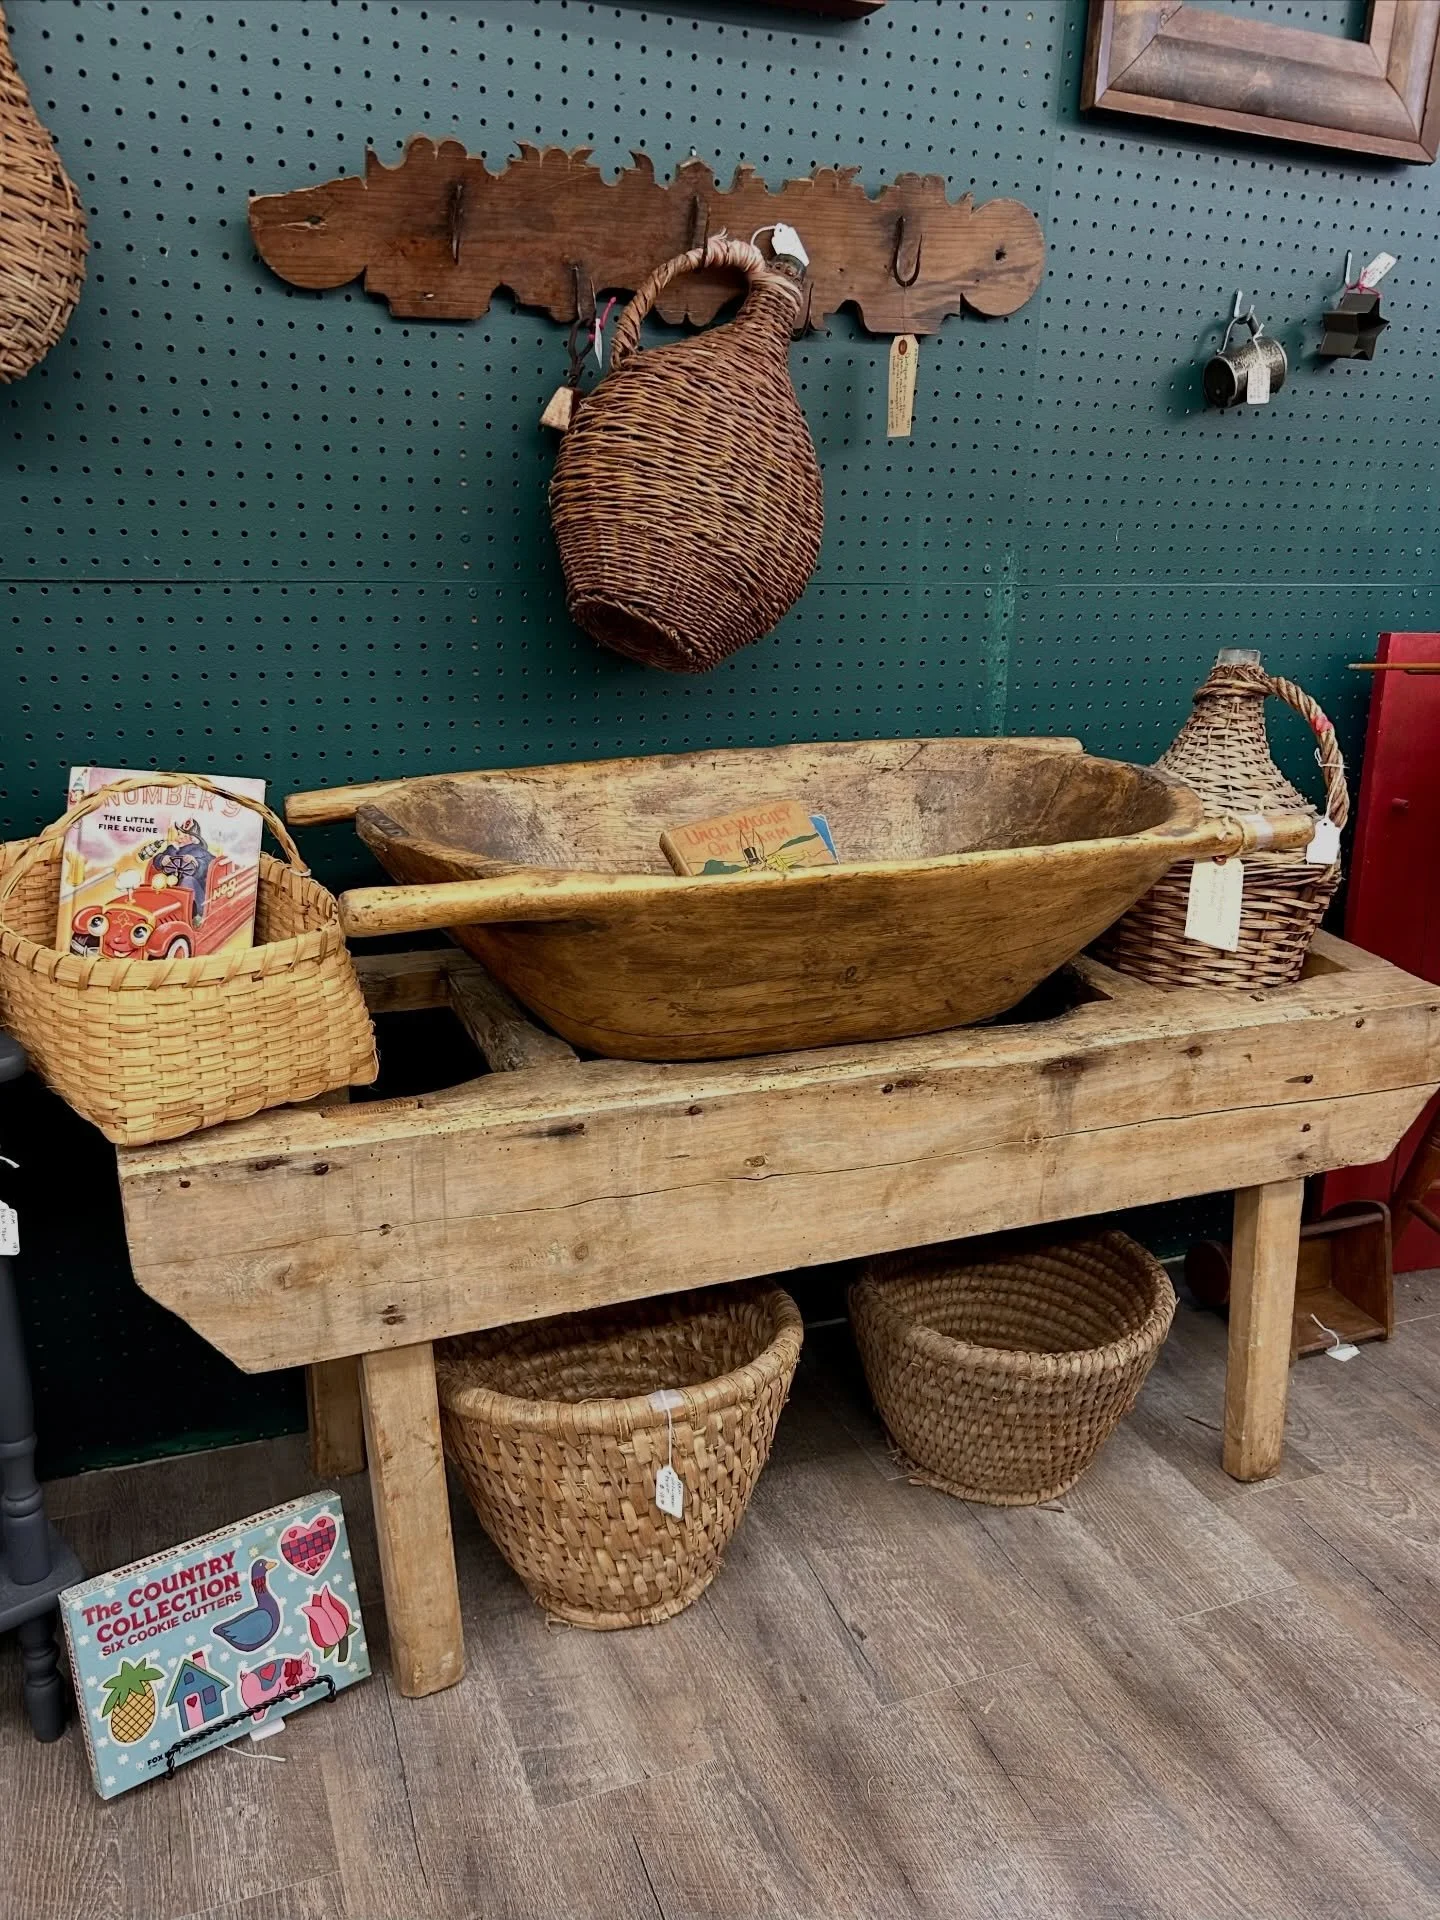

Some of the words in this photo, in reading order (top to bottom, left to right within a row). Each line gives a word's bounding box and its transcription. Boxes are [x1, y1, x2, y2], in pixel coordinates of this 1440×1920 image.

[98, 824, 120, 832] FIRE
[123, 825, 159, 834] ENGINE
[104, 814, 122, 822] THE
[125, 816, 155, 825] LITTLE
[684, 822, 733, 846] UNCLE
[240, 1508, 285, 1527] METAL
[182, 1527, 236, 1551] COOKIE
[112, 1550, 178, 1577] CUTTERS
[82, 1601, 123, 1626] The
[128, 1550, 236, 1608] COUNTRY
[97, 1571, 241, 1643] COLLECTION
[102, 1639, 126, 1657] SIX
[127, 1616, 180, 1645] COOKIE
[182, 1590, 243, 1622] CUTTERS
[147, 1754, 164, 1766] FOX
